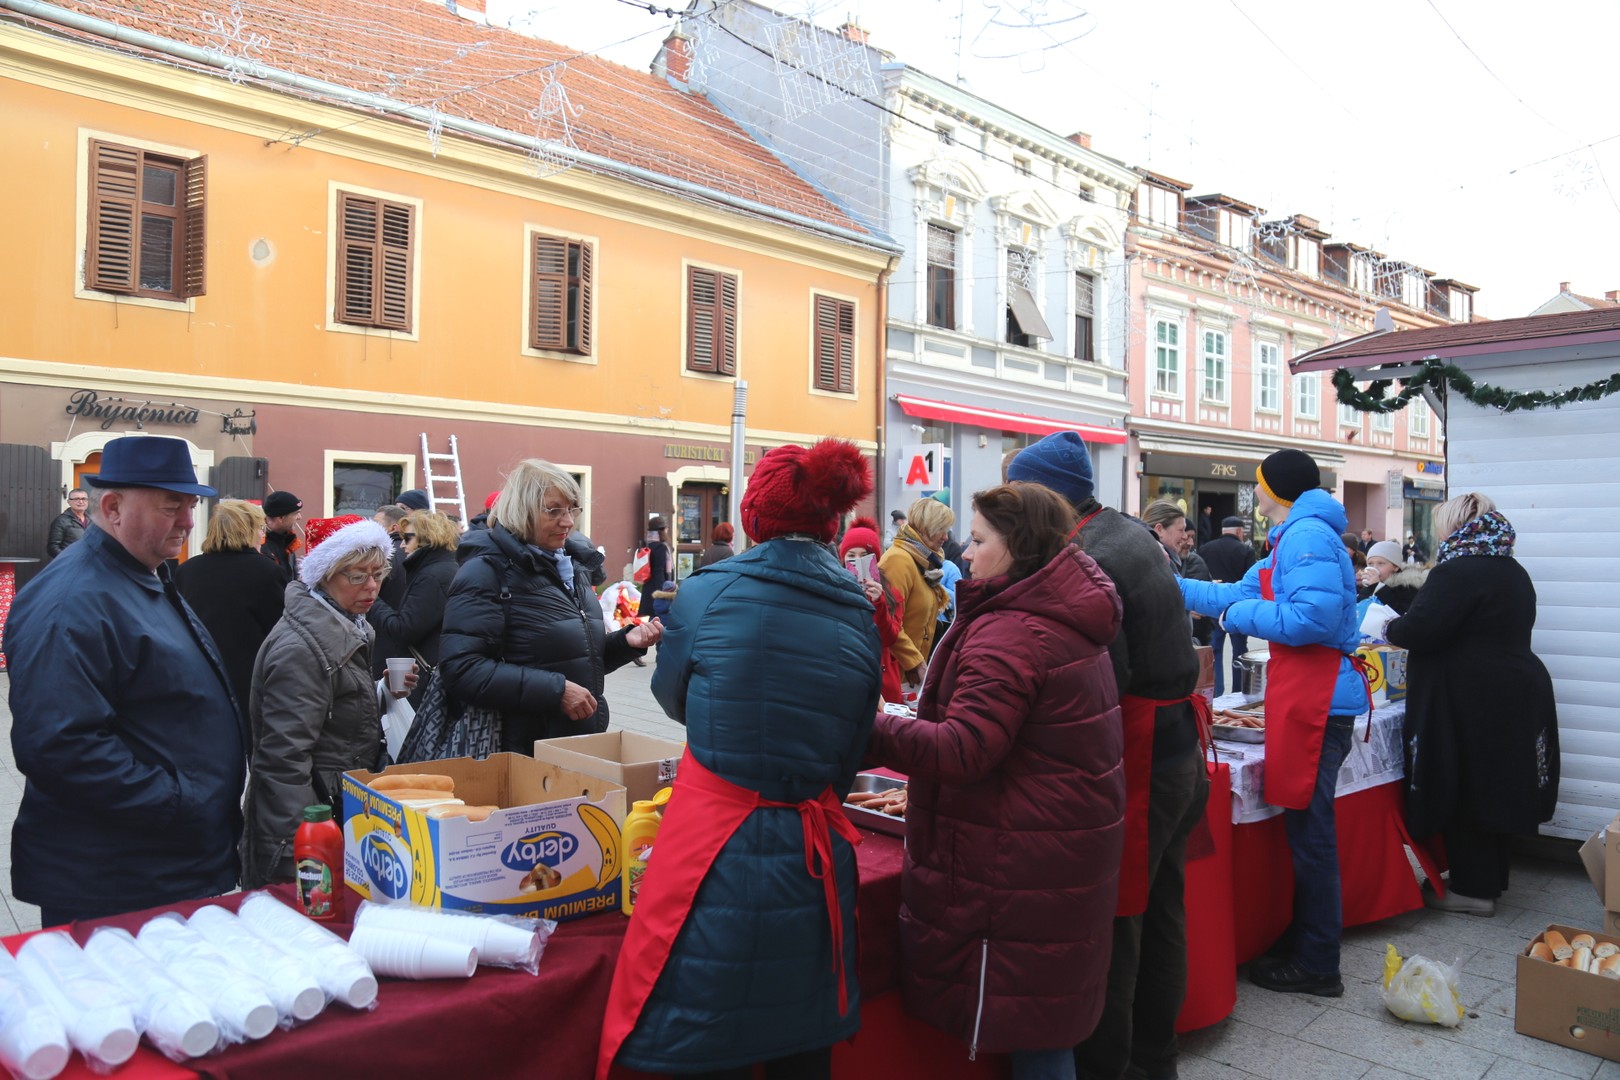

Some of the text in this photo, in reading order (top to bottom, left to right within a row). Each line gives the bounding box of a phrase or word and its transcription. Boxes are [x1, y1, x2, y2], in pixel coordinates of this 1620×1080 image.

[665, 443, 724, 462] TURISTIČKI
[905, 450, 934, 486] A1
[1211, 463, 1237, 477] ZAKS
[369, 794, 402, 823] PREMIUM
[525, 822, 556, 834] QUALITY
[507, 836, 573, 867] derby
[364, 835, 404, 900] derby
[543, 892, 616, 919] PREMIUM
